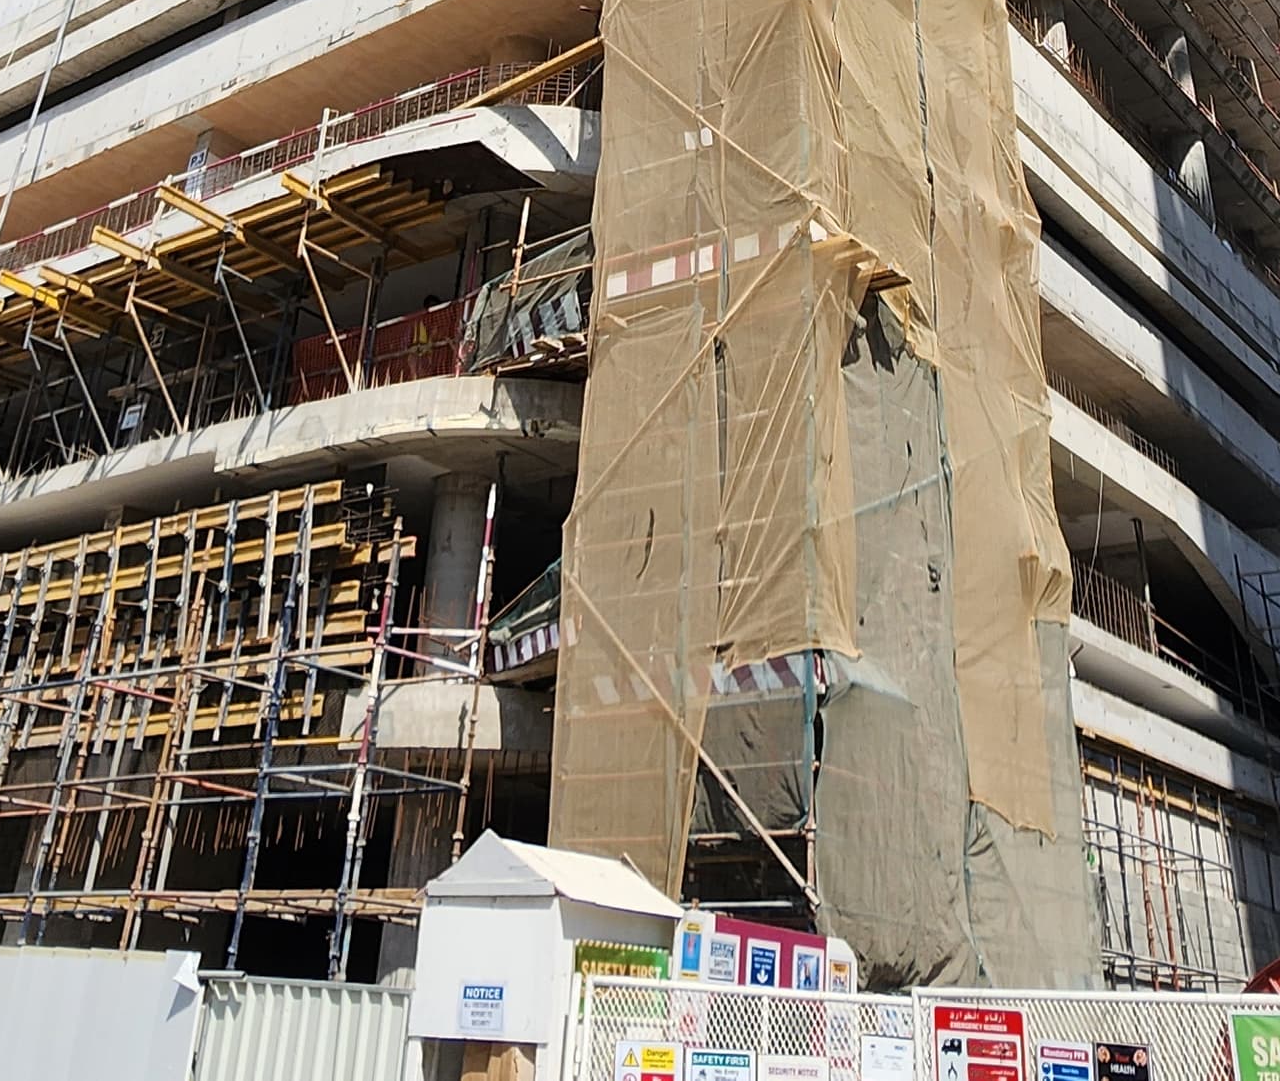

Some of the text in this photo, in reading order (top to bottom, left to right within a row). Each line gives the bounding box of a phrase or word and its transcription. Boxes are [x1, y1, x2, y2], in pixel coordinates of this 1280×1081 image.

[465, 987, 501, 999] NOTICE
[693, 1054, 749, 1067] SAFETY FIRST
[1110, 1063, 1135, 1074] HEALTH
